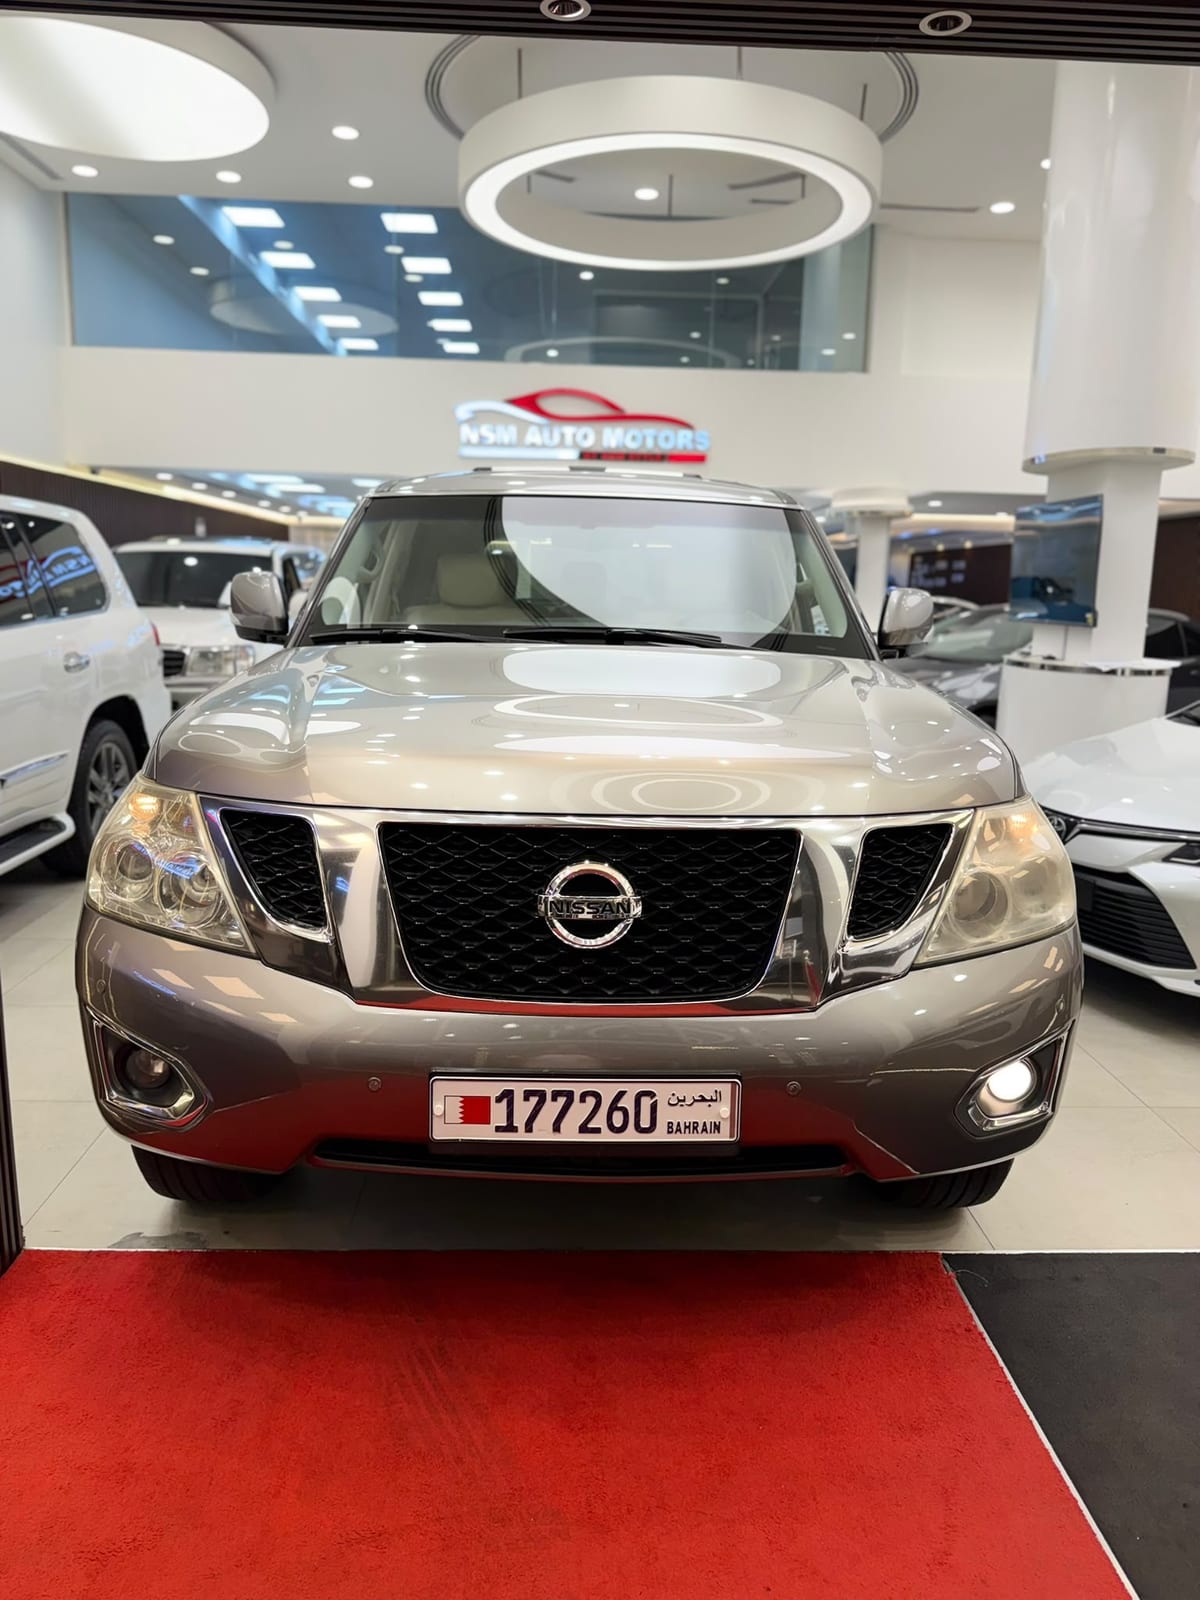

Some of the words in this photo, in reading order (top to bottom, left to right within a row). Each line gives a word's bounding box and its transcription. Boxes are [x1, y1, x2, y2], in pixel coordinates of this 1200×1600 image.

[460, 425, 516, 445] NSM
[525, 426, 596, 447] AUTO
[603, 428, 709, 450] MOTORS
[549, 900, 631, 915] NISSAN
[667, 1090, 722, 1107] البحرين
[494, 1088, 658, 1134] 177260
[667, 1121, 721, 1135] BAHRAIN
